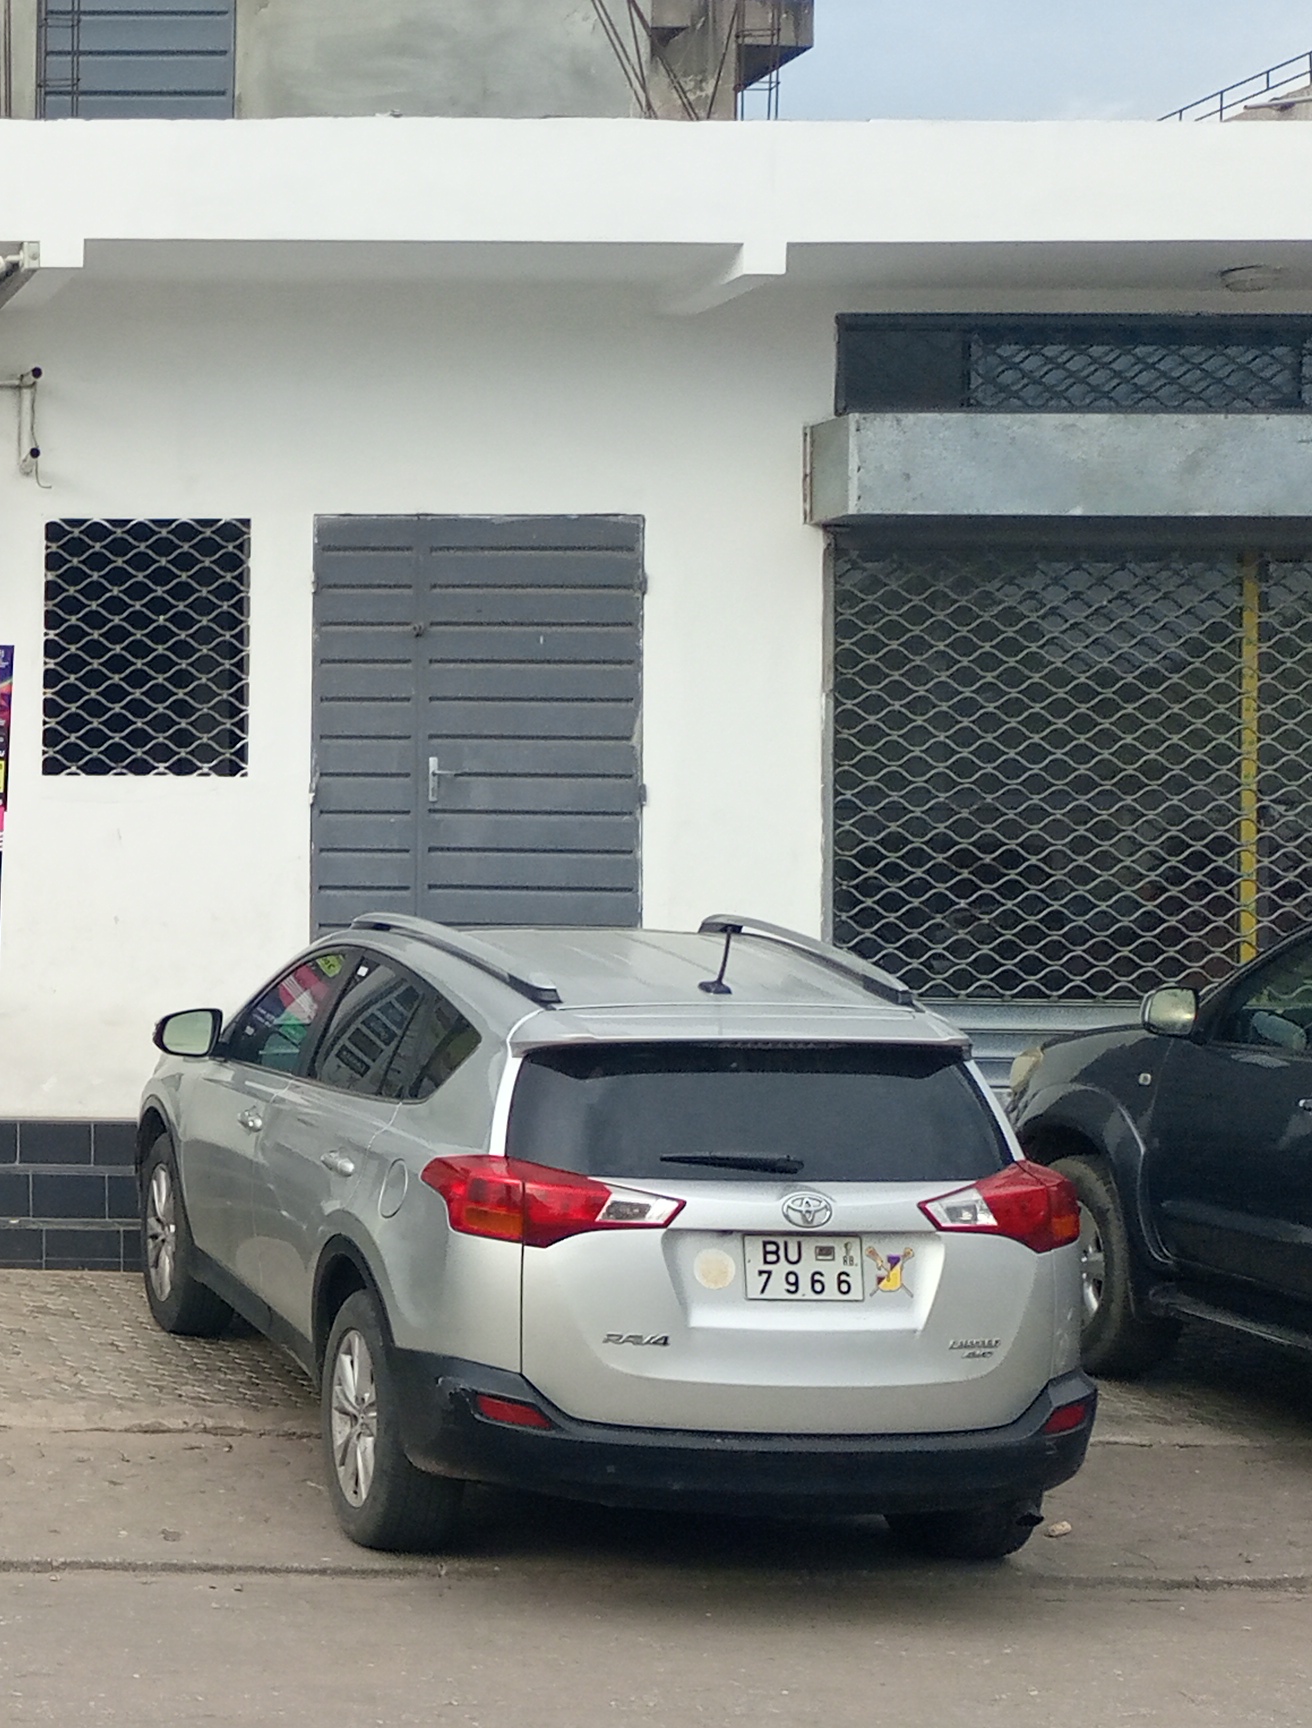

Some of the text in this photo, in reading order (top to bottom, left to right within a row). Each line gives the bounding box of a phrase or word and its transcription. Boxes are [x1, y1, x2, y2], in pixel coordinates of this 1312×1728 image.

[762, 1241, 802, 1264] BU
[758, 1270, 852, 1295] 7966
[602, 1332, 670, 1346] RAV4
